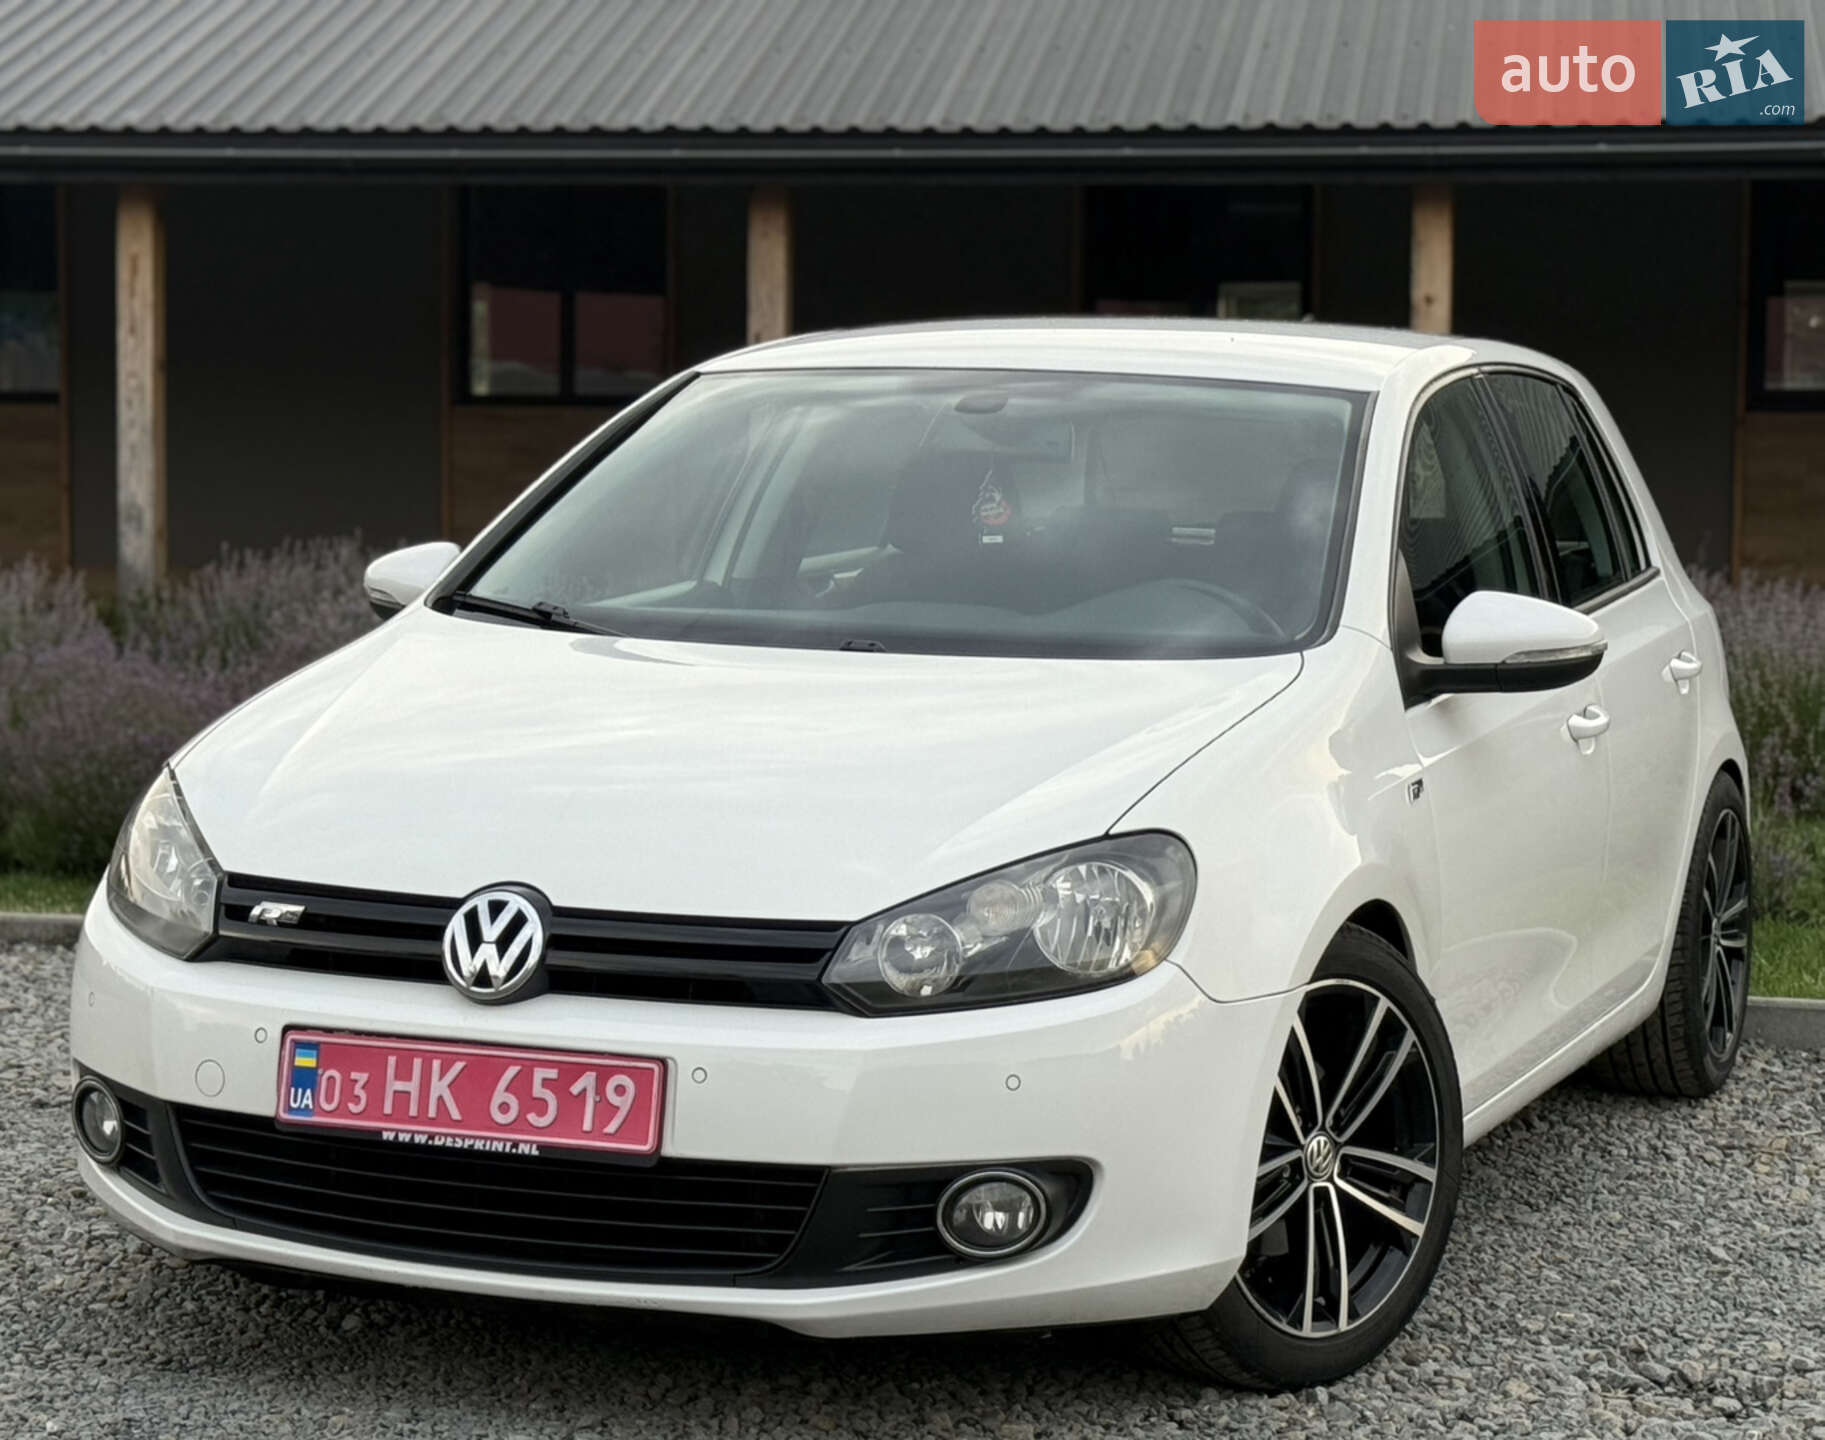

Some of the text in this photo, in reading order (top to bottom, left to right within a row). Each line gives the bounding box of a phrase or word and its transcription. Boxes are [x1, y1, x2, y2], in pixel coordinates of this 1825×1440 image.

[444, 891, 544, 994] VW
[289, 1087, 314, 1110] UA
[319, 1055, 636, 1135] 03 HK 6519
[381, 1129, 540, 1157] WWW.DESPRINT.NL
